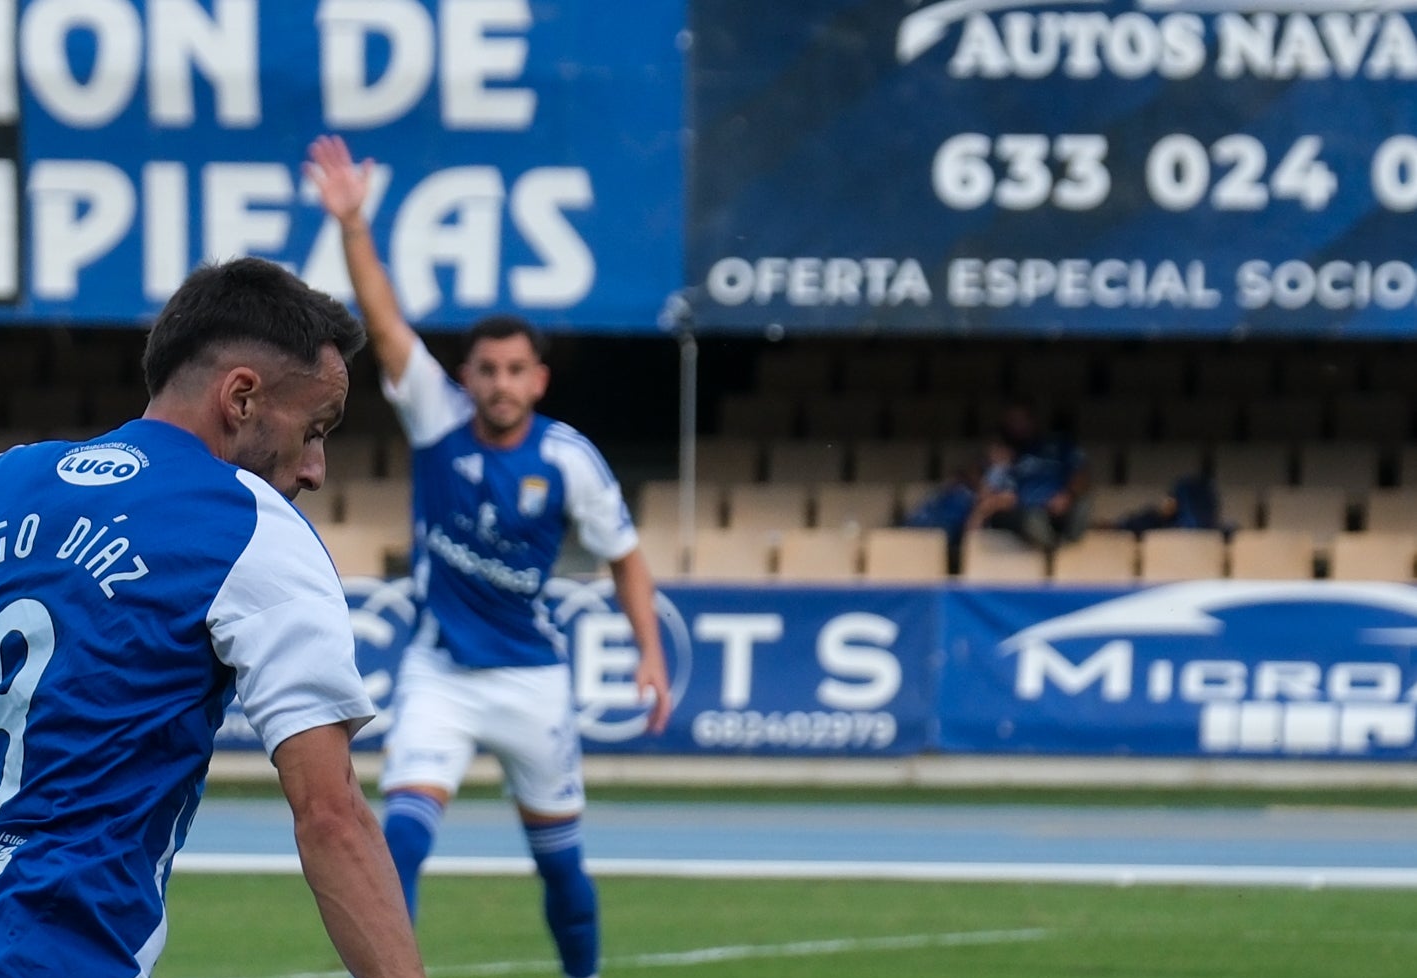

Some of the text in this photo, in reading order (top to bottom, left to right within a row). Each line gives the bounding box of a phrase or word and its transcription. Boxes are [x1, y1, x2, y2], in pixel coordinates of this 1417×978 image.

[317, 0, 538, 131] DE
[947, 12, 1207, 79] AUTOS
[931, 132, 1112, 212] 633
[1145, 133, 1338, 212] 024
[706, 256, 932, 307] OFERTA
[947, 258, 1221, 309] ESPECIAL
[60, 456, 136, 478] LUGO
[55, 514, 150, 600] DÍAZ
